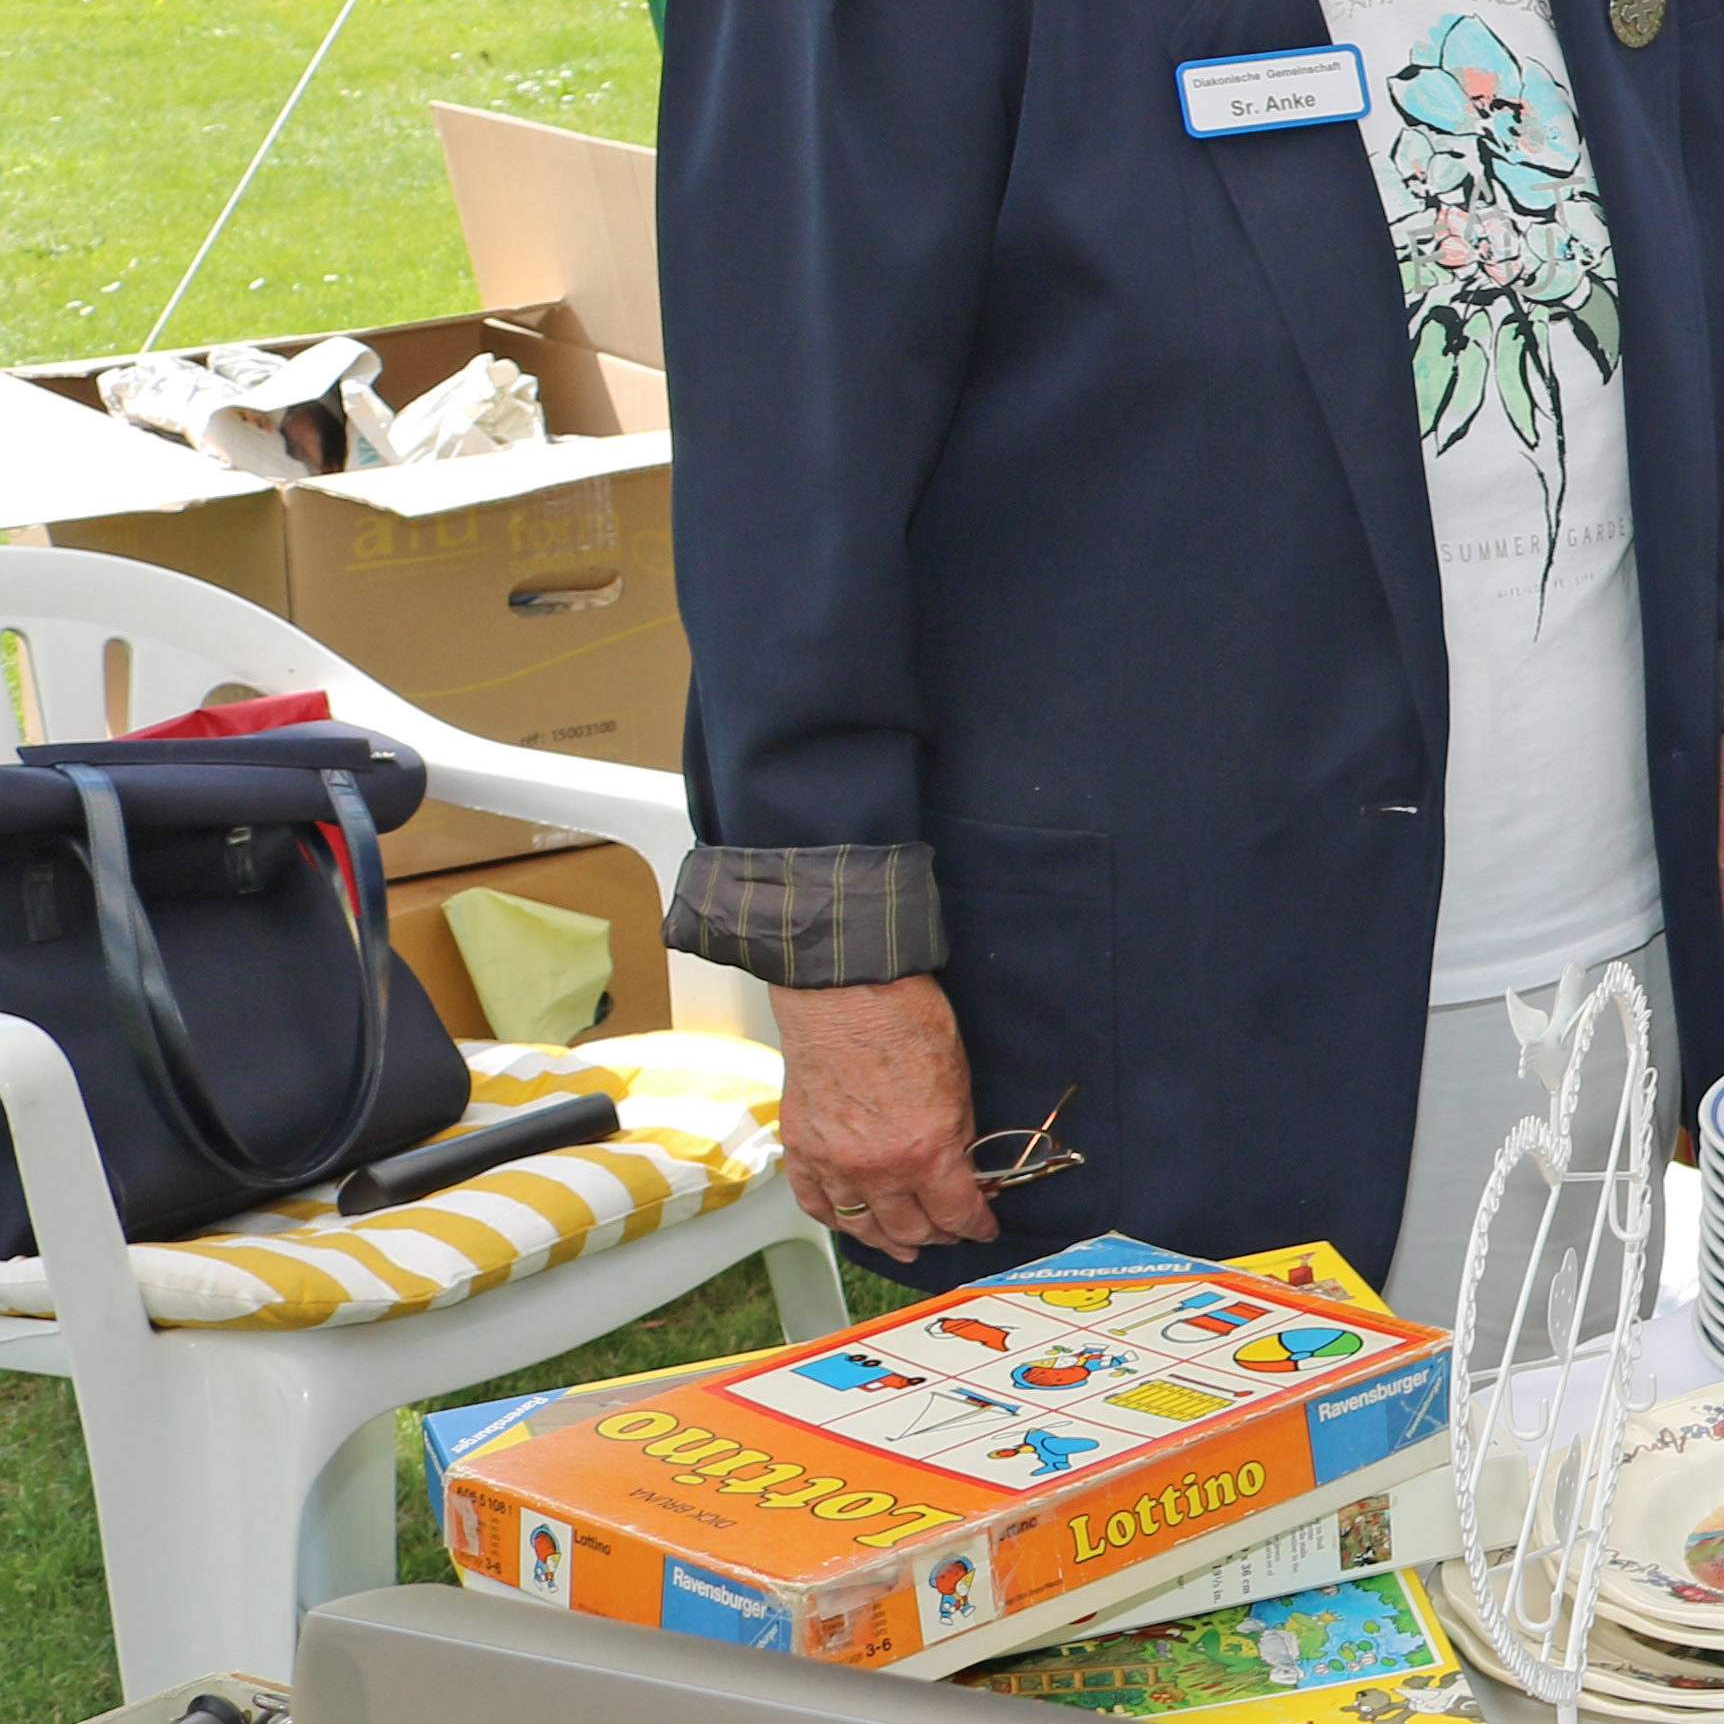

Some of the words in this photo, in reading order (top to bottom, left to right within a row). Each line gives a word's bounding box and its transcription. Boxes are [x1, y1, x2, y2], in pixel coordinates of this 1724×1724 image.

[1192, 71, 1262, 89] Diakonische
[1266, 61, 1342, 80] Gemeinschaft
[1230, 99, 1260, 117] Sr.
[1265, 92, 1317, 113] Anke
[1440, 534, 1541, 563] SUMMER
[1007, 1262, 1193, 1280] Ravensburger
[1317, 1367, 1432, 1423] Ravensburger
[451, 1395, 550, 1455] Ravensburger
[595, 1409, 965, 1549] Lottino
[629, 1486, 696, 1515] BRUNA
[1067, 1460, 1267, 1564] Lottino
[574, 1528, 612, 1556] Lottino
[671, 1564, 768, 1620] Ravensburger
[865, 1637, 893, 1658] 3-6
